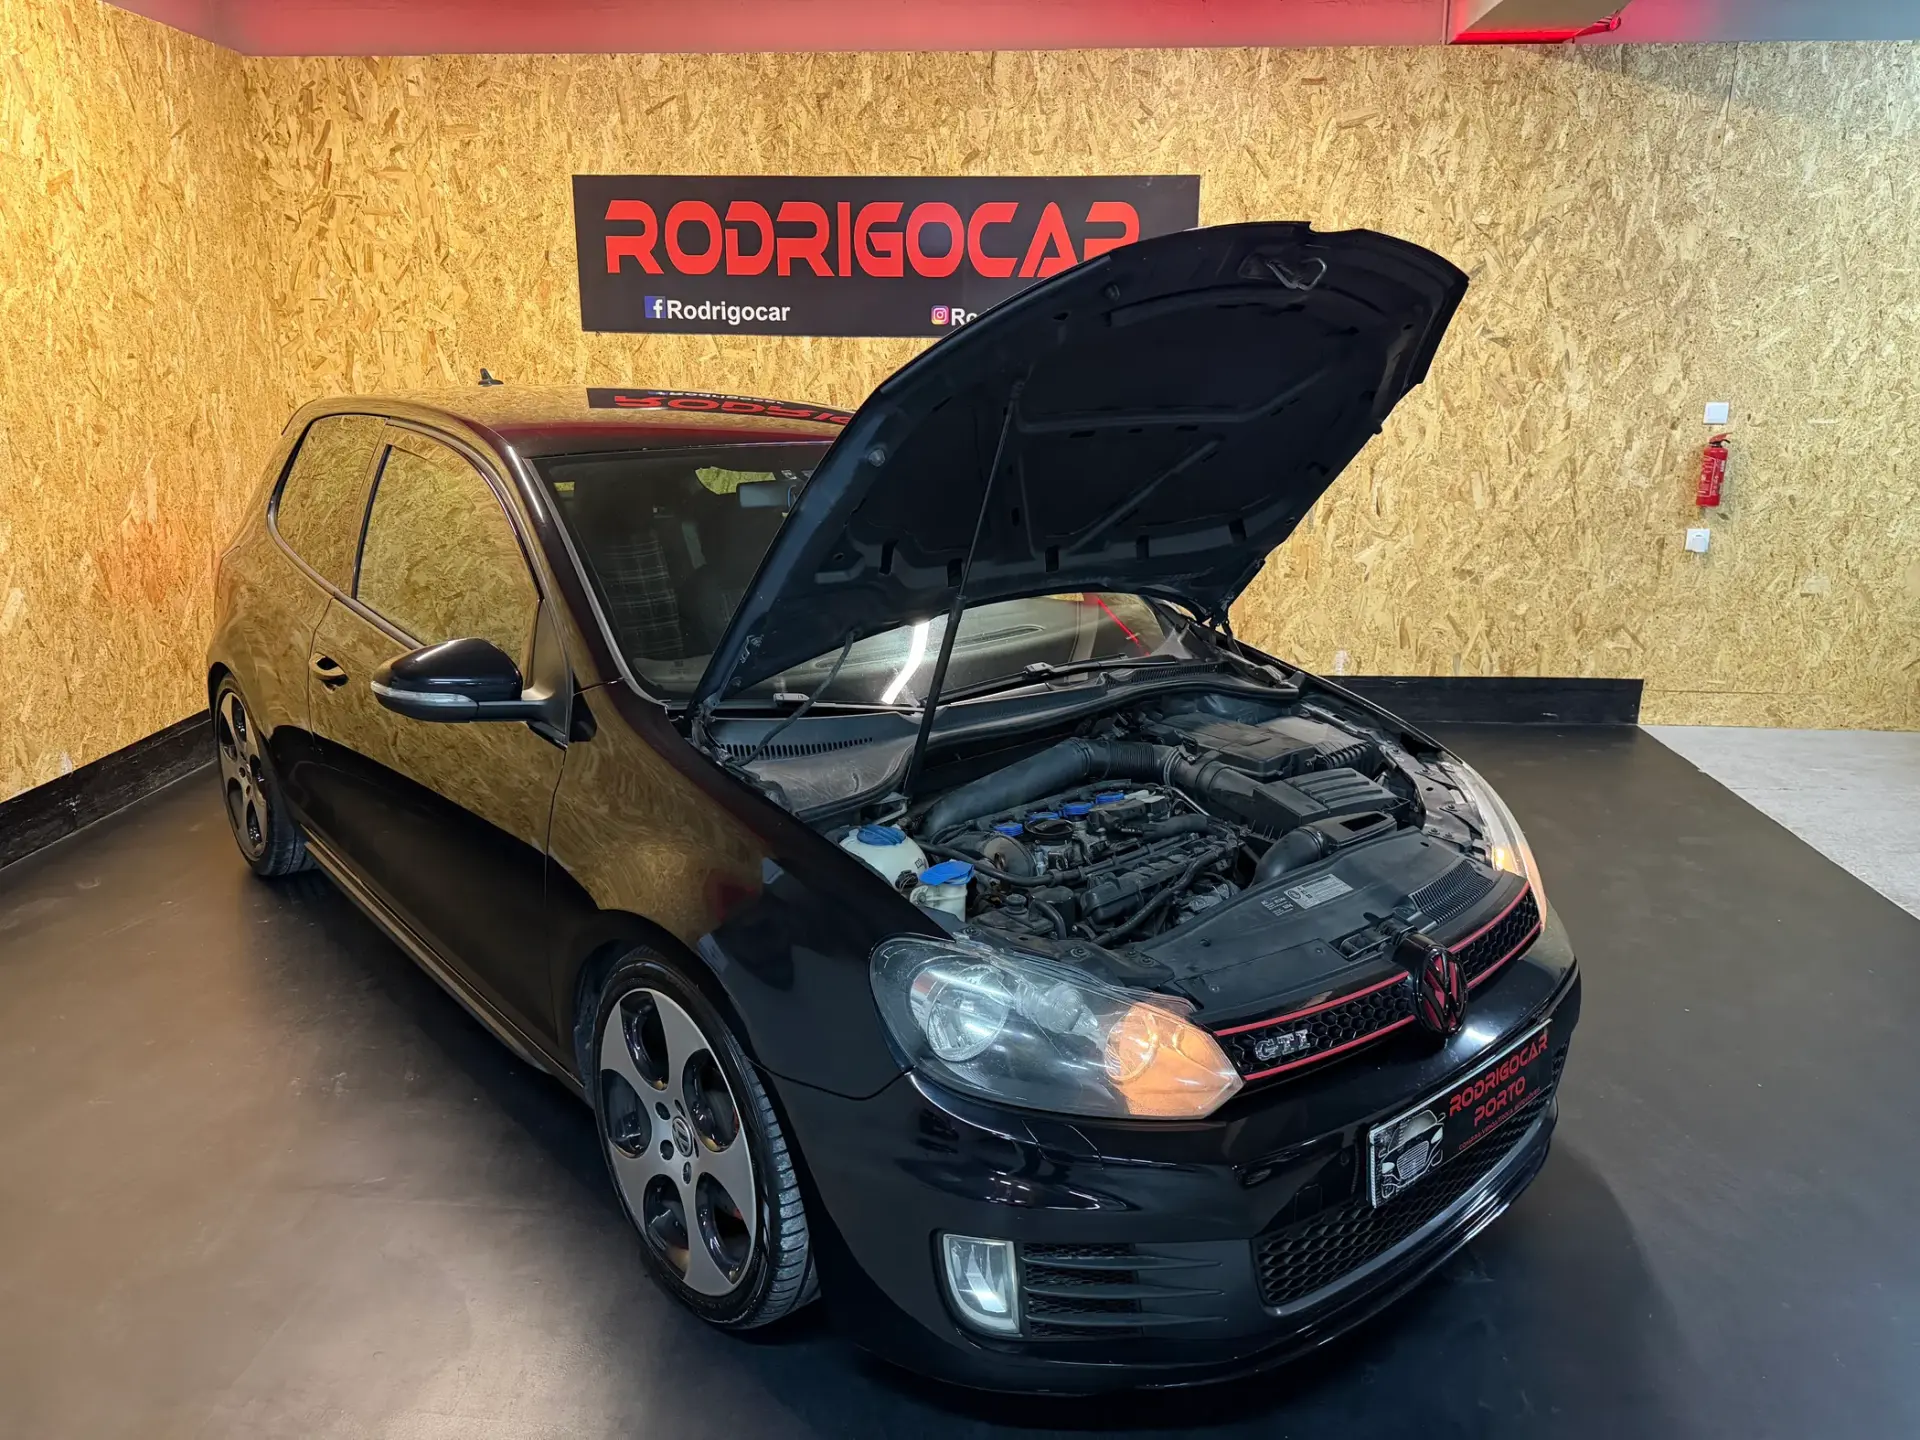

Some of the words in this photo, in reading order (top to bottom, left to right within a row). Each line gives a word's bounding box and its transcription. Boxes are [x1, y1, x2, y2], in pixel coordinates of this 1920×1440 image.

[605, 200, 1140, 278] RODRIGOCAR
[667, 300, 791, 325] Rodrigocar
[1255, 1029, 1311, 1061] GTI
[1449, 1033, 1548, 1117] RODRIGOCAR
[1473, 1076, 1526, 1127] PORTO
